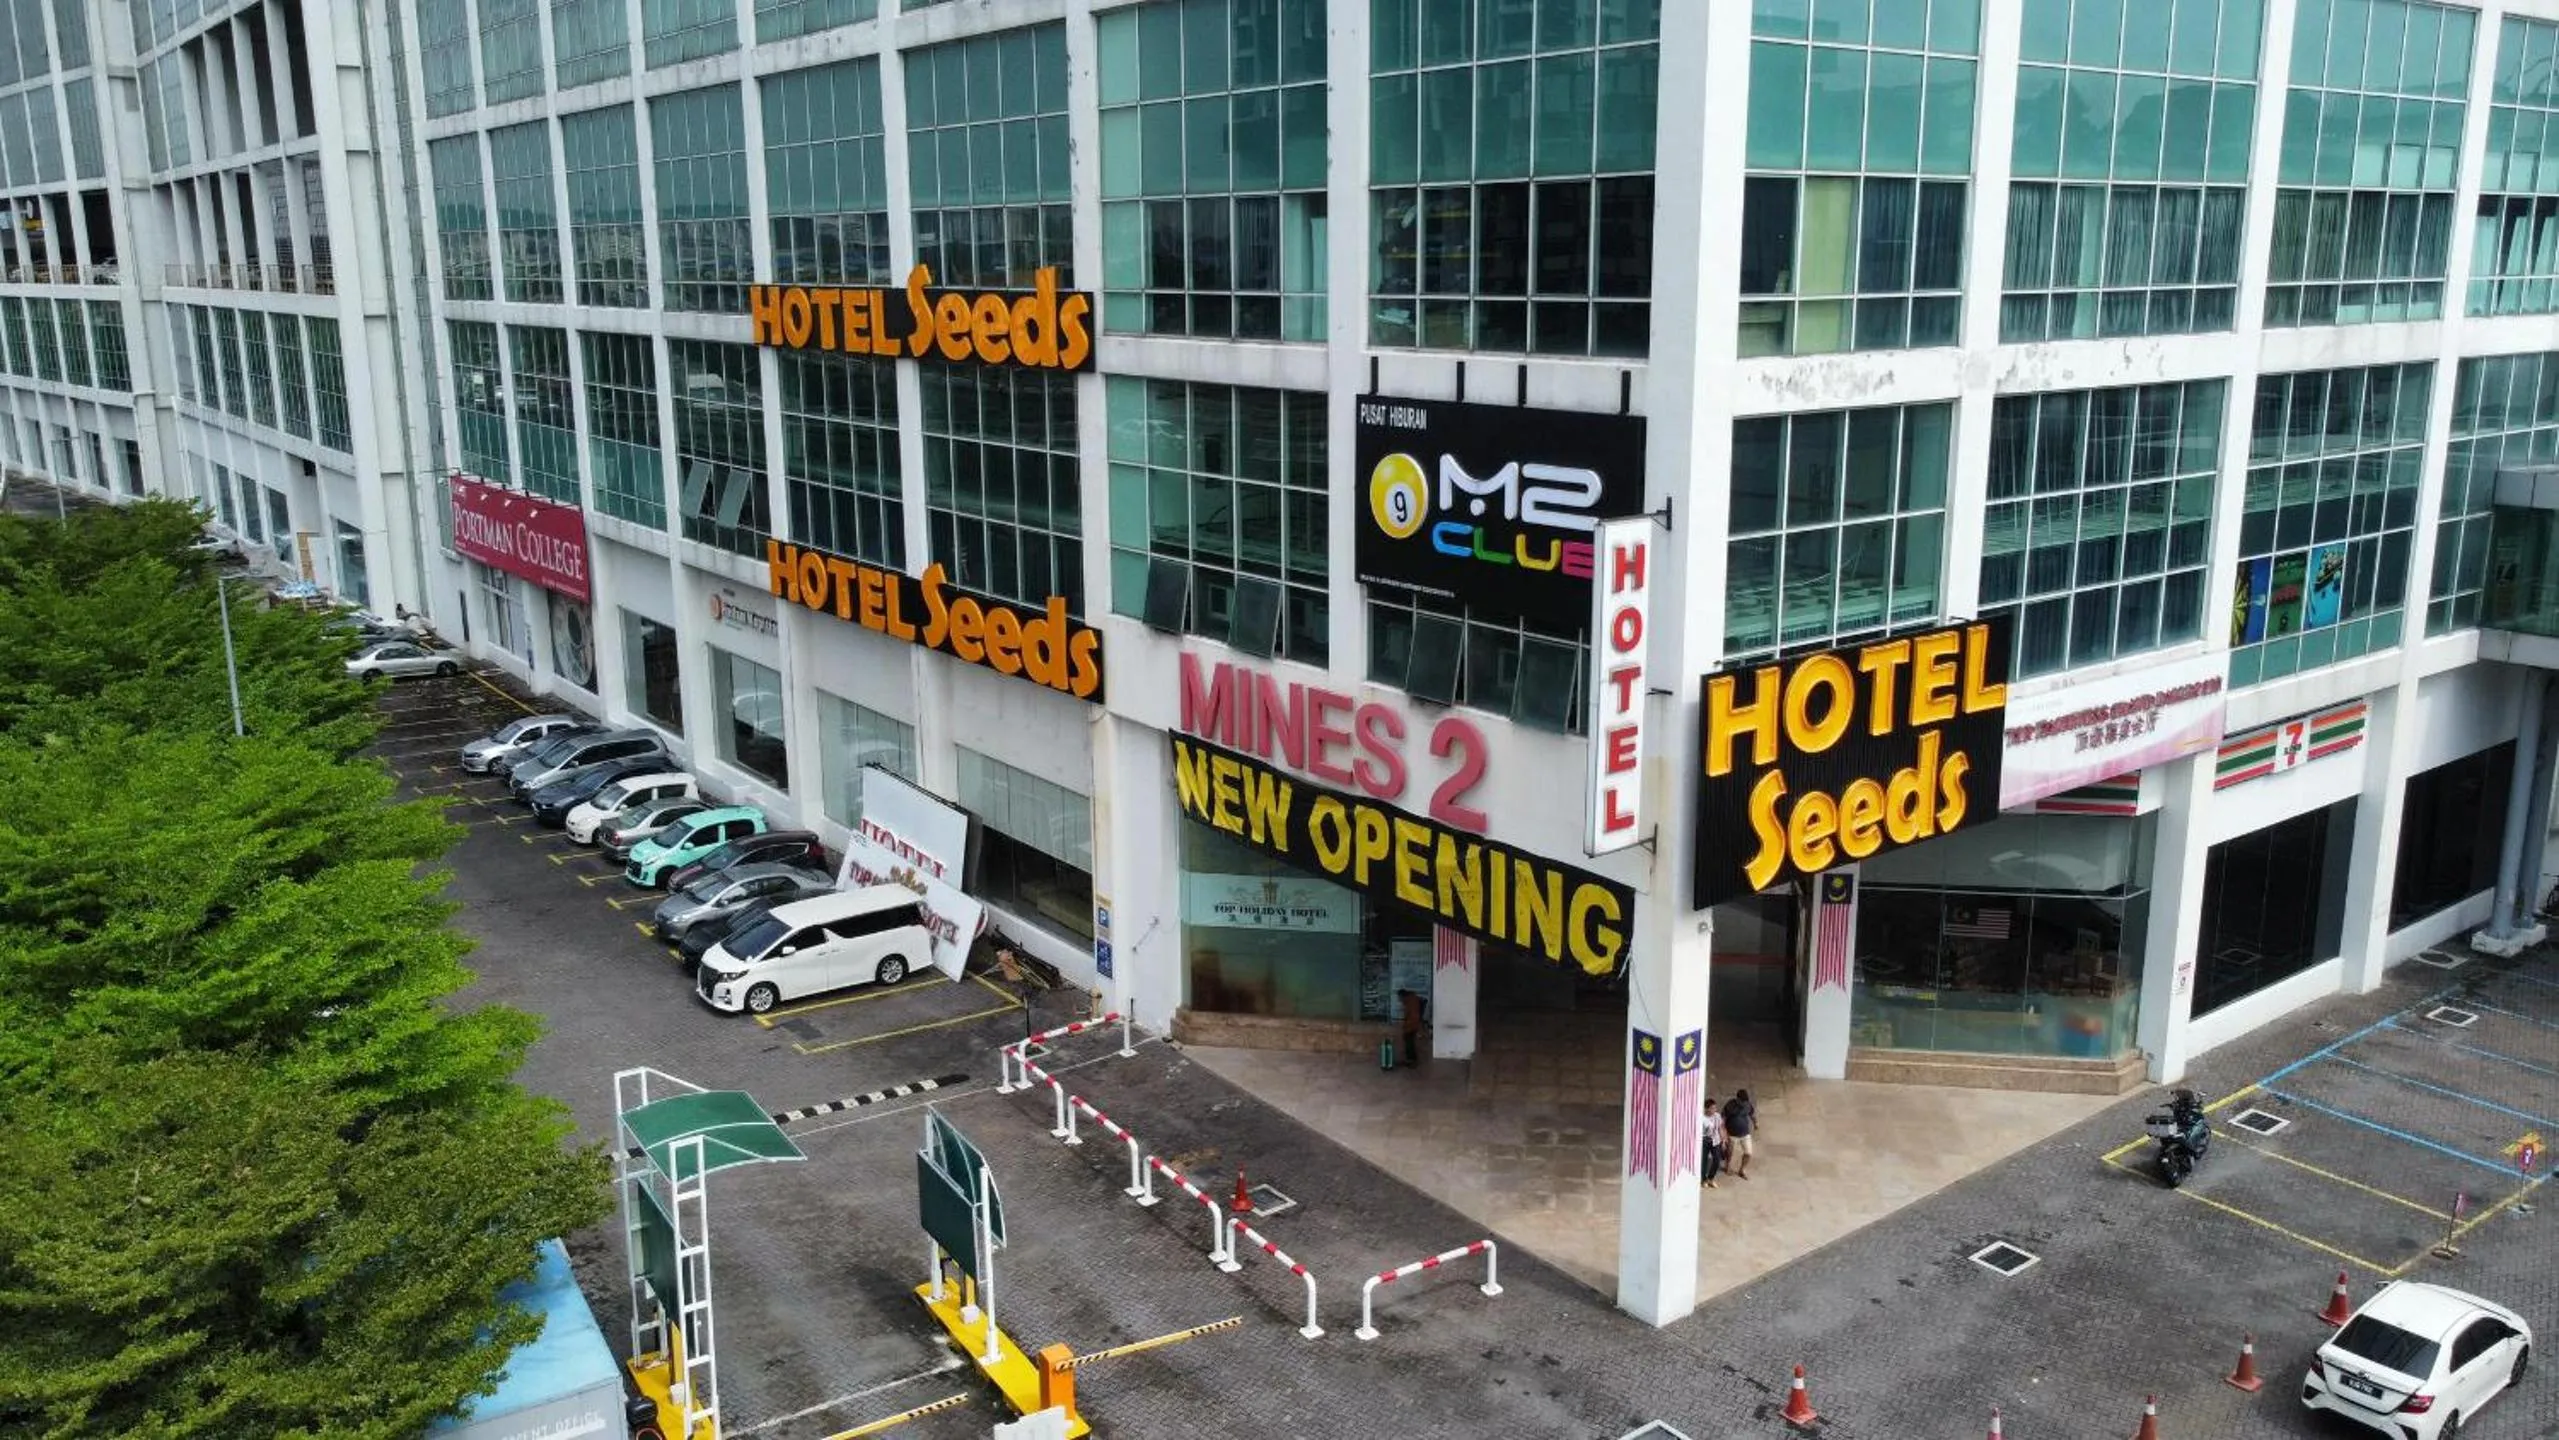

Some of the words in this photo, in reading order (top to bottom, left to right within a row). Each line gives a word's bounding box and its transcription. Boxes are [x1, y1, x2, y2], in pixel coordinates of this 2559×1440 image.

[751, 286, 900, 357] HOTEL
[907, 264, 1089, 370] Seeds
[1361, 403, 1386, 425] PUSAT
[1390, 406, 1427, 431] HIBURAN
[1439, 453, 1602, 531] M2
[453, 501, 514, 556] PORTMAN
[516, 523, 584, 581] COLLEGE
[767, 540, 915, 641] HOTEL
[921, 563, 1098, 697] Seeds
[1180, 652, 1407, 800] MINES
[1429, 717, 1488, 834] 2
[1603, 543, 1646, 834] HOTEL
[1706, 624, 2006, 777] HOTEL
[1174, 741, 1293, 852] NEW
[1308, 794, 1624, 976] OPENING
[1744, 730, 1969, 891] Seeds
